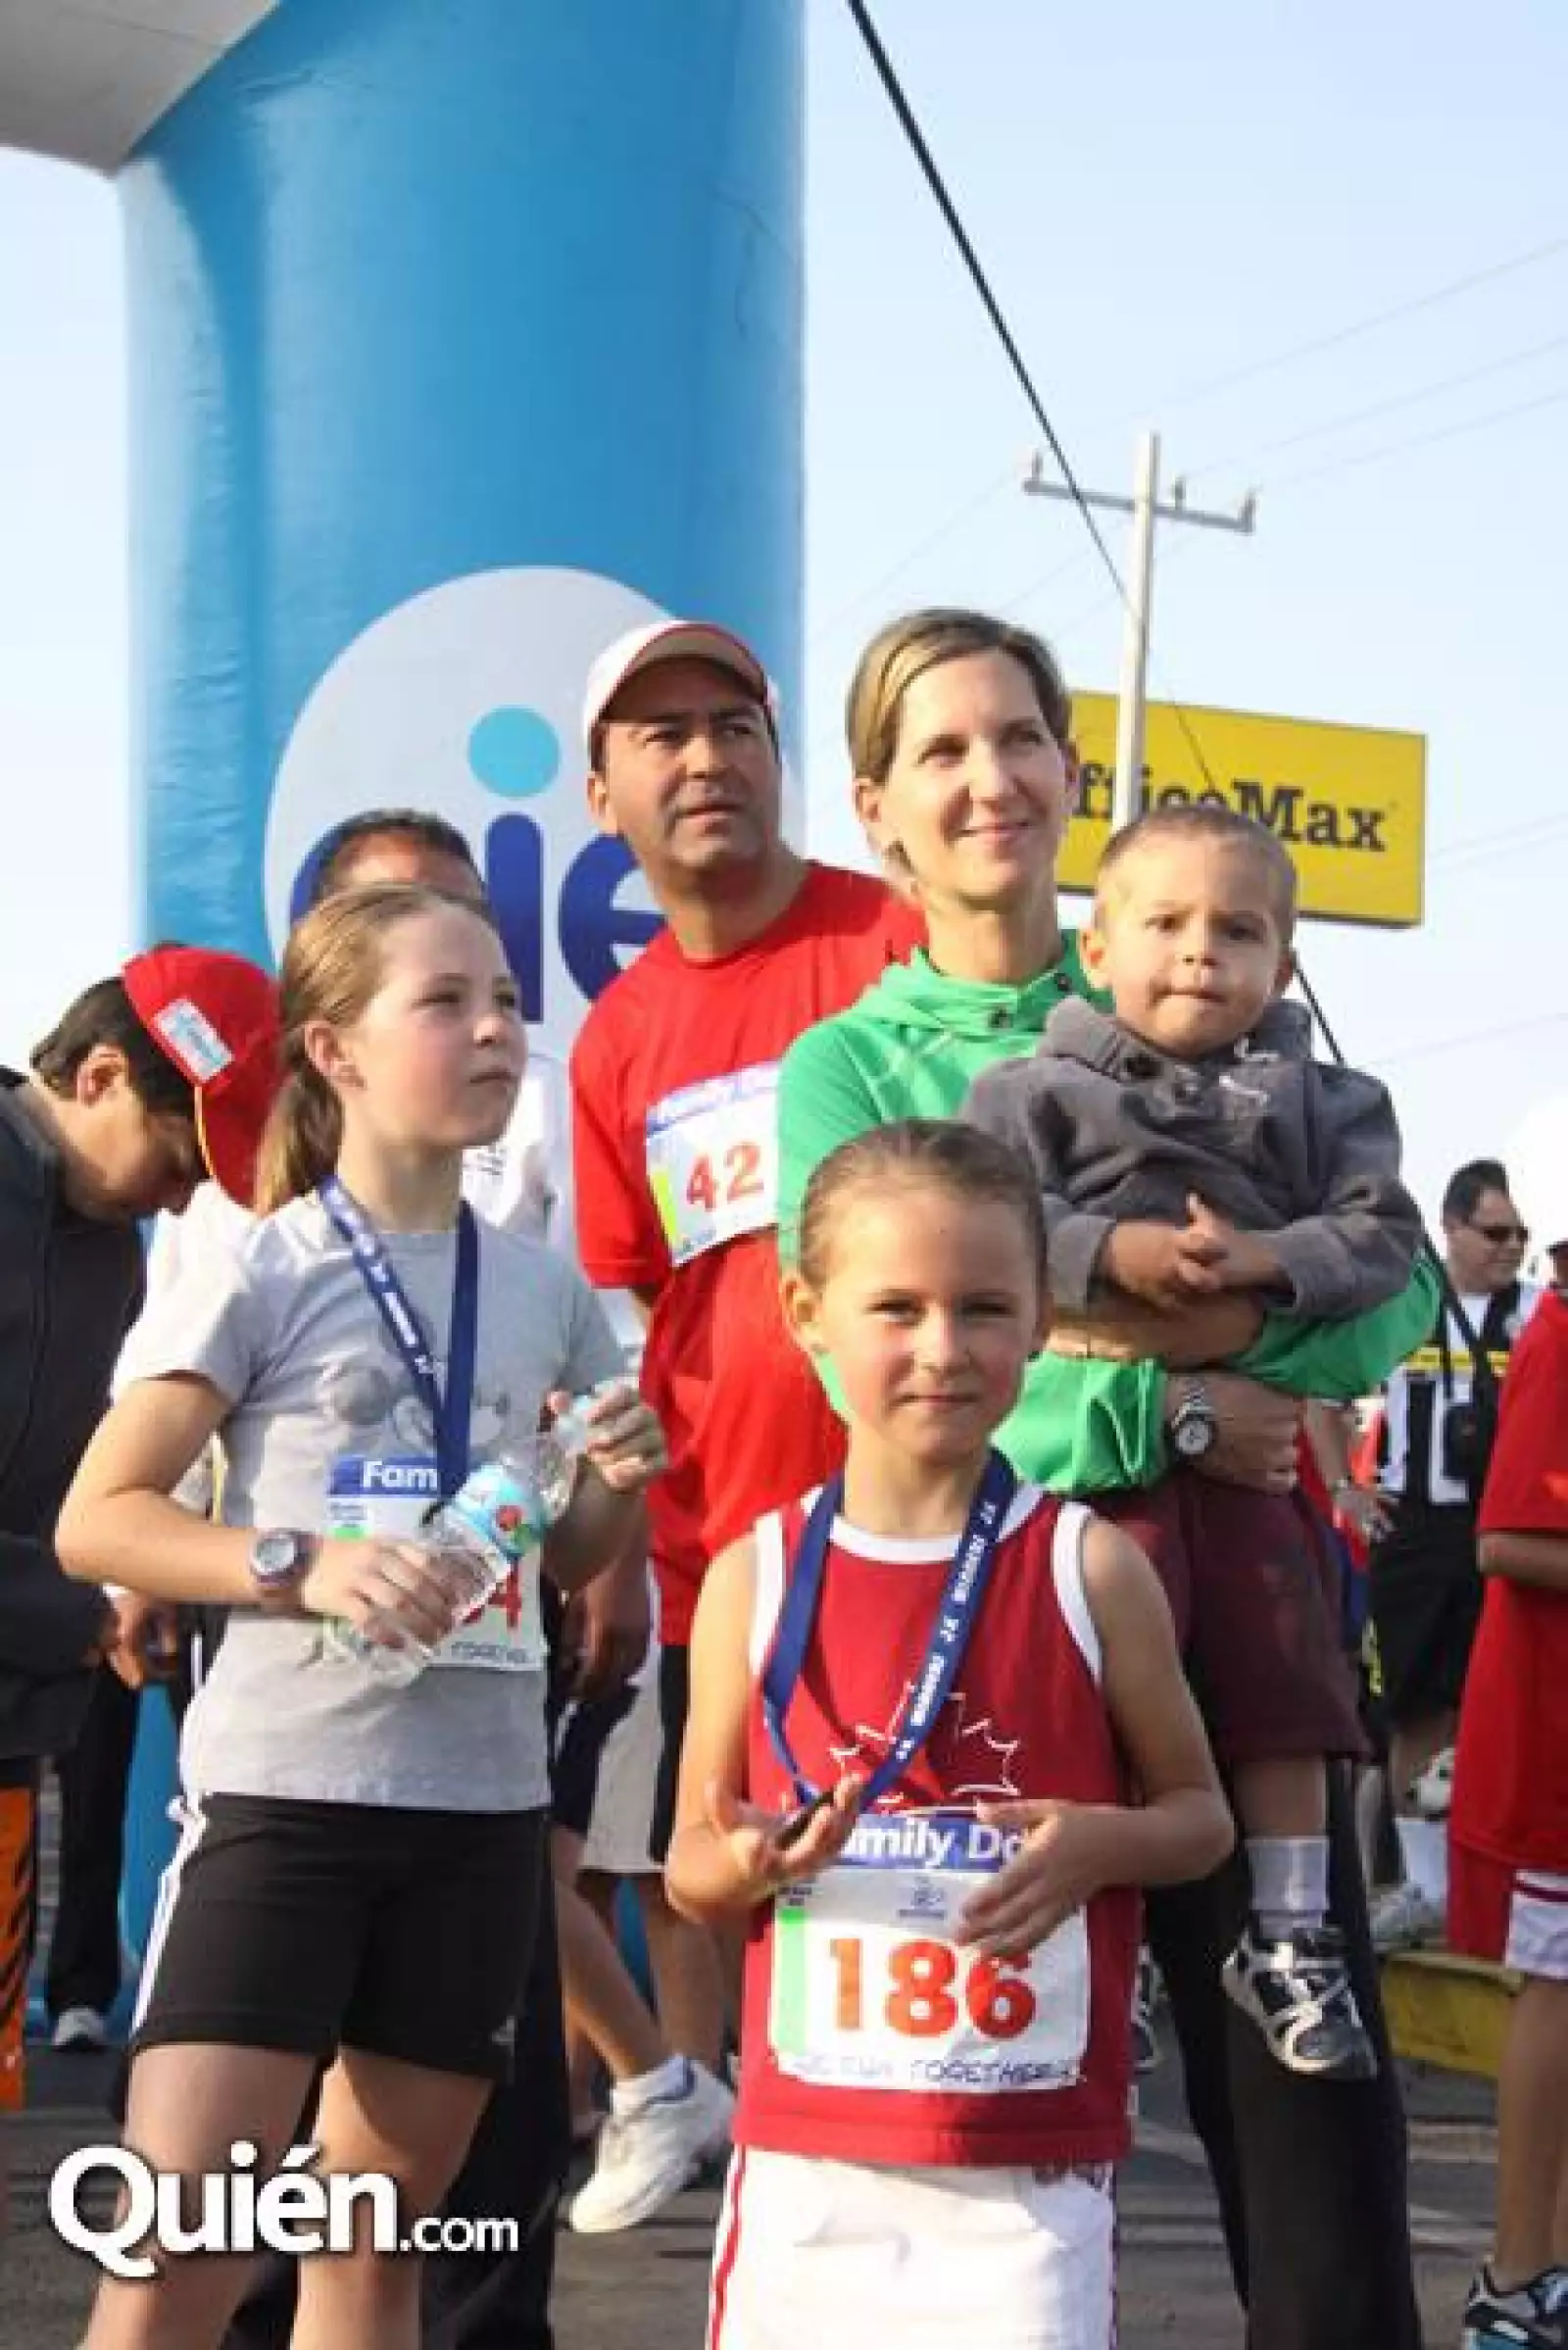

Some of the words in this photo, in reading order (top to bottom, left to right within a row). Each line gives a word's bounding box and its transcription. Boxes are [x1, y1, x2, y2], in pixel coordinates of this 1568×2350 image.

[686, 1141, 764, 1212] 42
[363, 1460, 437, 1489] Fam
[829, 1938, 1037, 2039] 186
